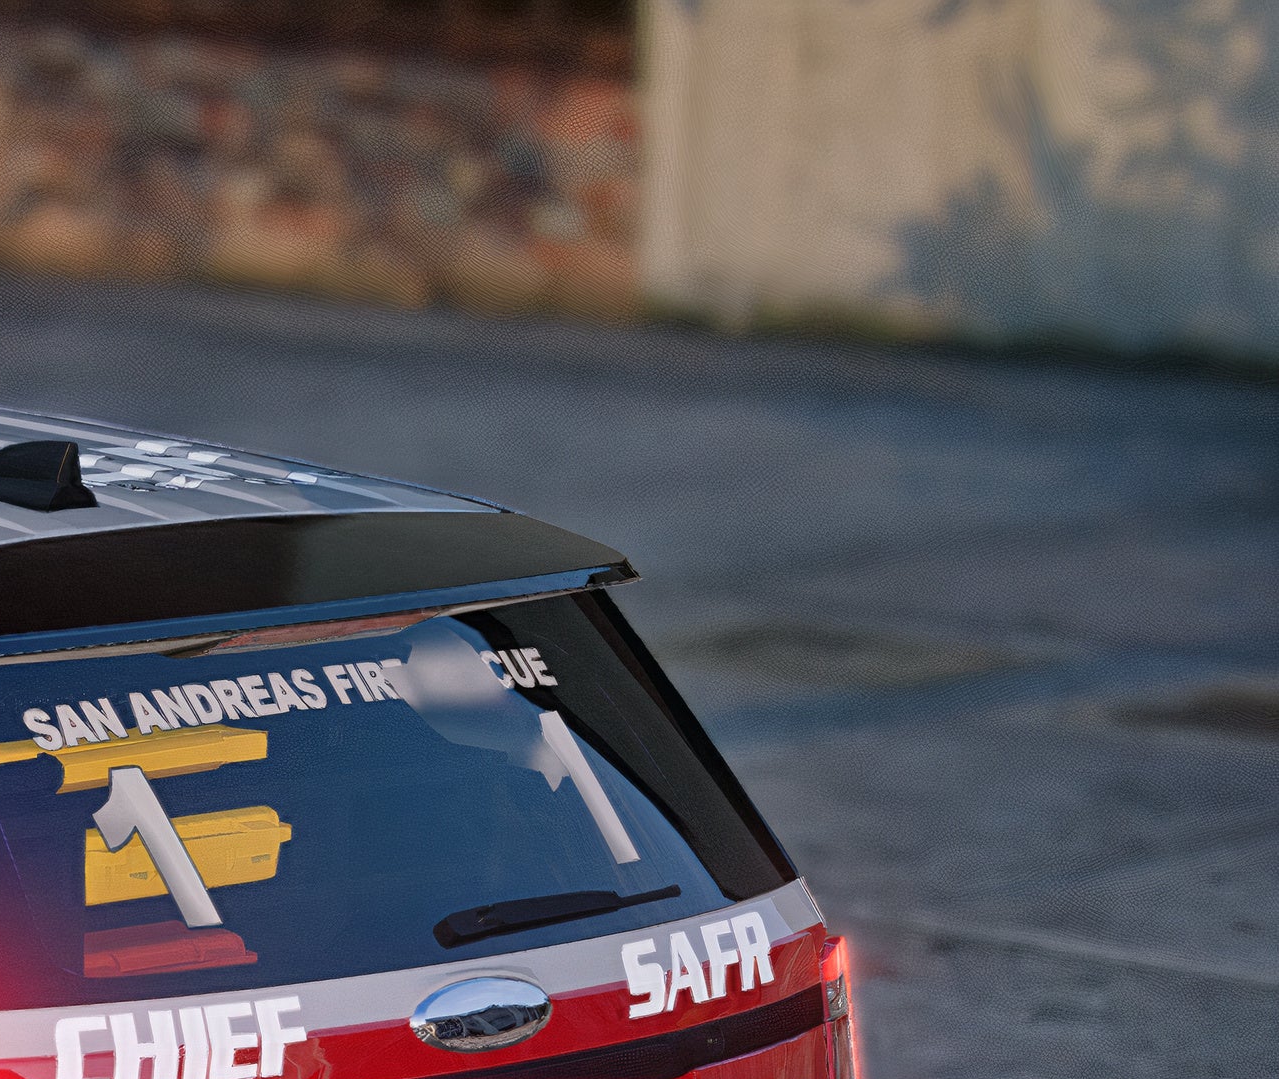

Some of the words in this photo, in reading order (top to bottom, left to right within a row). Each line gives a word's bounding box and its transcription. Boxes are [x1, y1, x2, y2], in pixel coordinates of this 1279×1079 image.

[22, 697, 128, 752] SAN
[128, 667, 329, 735] ANDREAS
[93, 766, 224, 929] 1
[539, 710, 641, 865] 1
[621, 911, 775, 1020] SAFR
